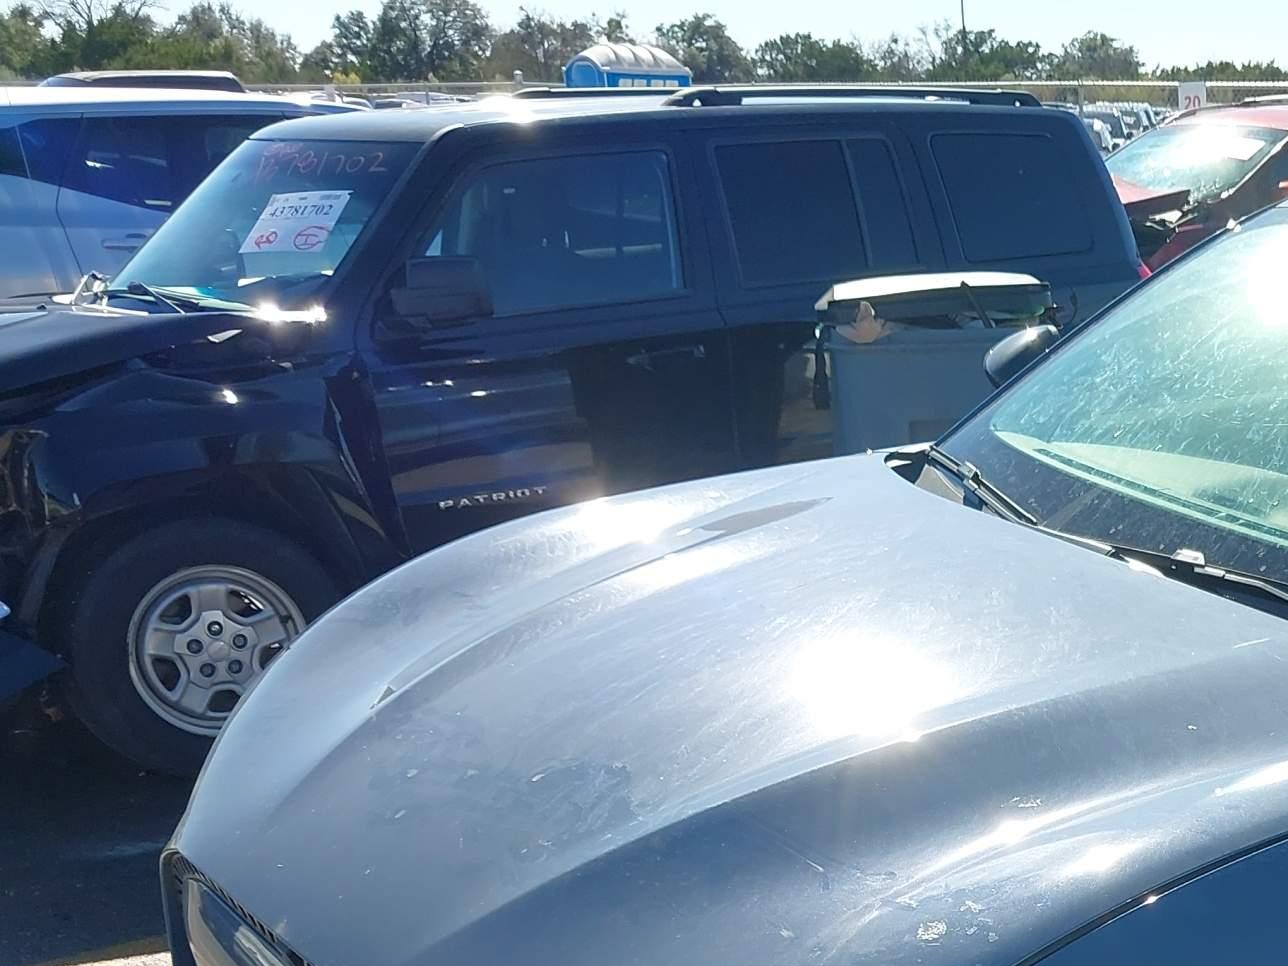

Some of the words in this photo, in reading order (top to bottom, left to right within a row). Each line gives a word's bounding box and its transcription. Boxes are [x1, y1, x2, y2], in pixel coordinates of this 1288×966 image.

[1184, 95, 1201, 109] 20
[268, 204, 334, 218] 43781702
[438, 485, 547, 510] PATRIOT
